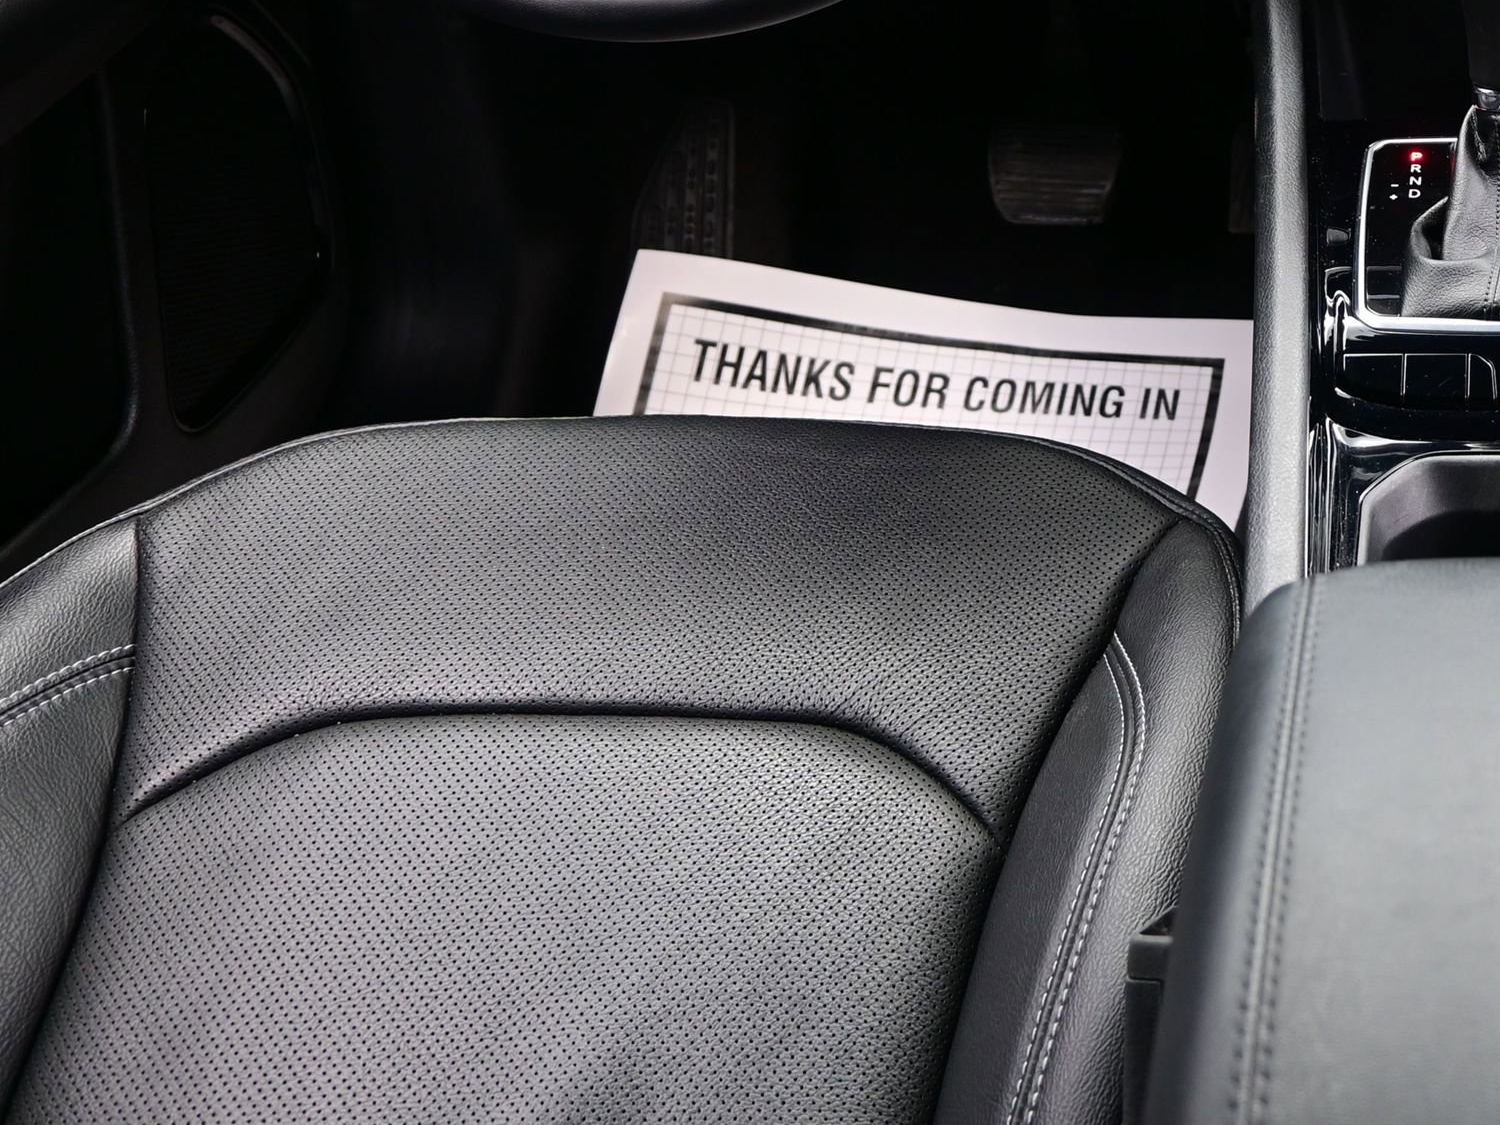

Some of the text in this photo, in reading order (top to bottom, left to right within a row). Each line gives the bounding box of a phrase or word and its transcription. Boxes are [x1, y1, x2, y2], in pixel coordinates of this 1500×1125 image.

[1410, 151, 1423, 162] P
[1410, 163, 1422, 173] R
[1409, 176, 1422, 186] N
[1408, 188, 1421, 199] D
[693, 338, 1181, 421] THANKS FOR COMING IN
